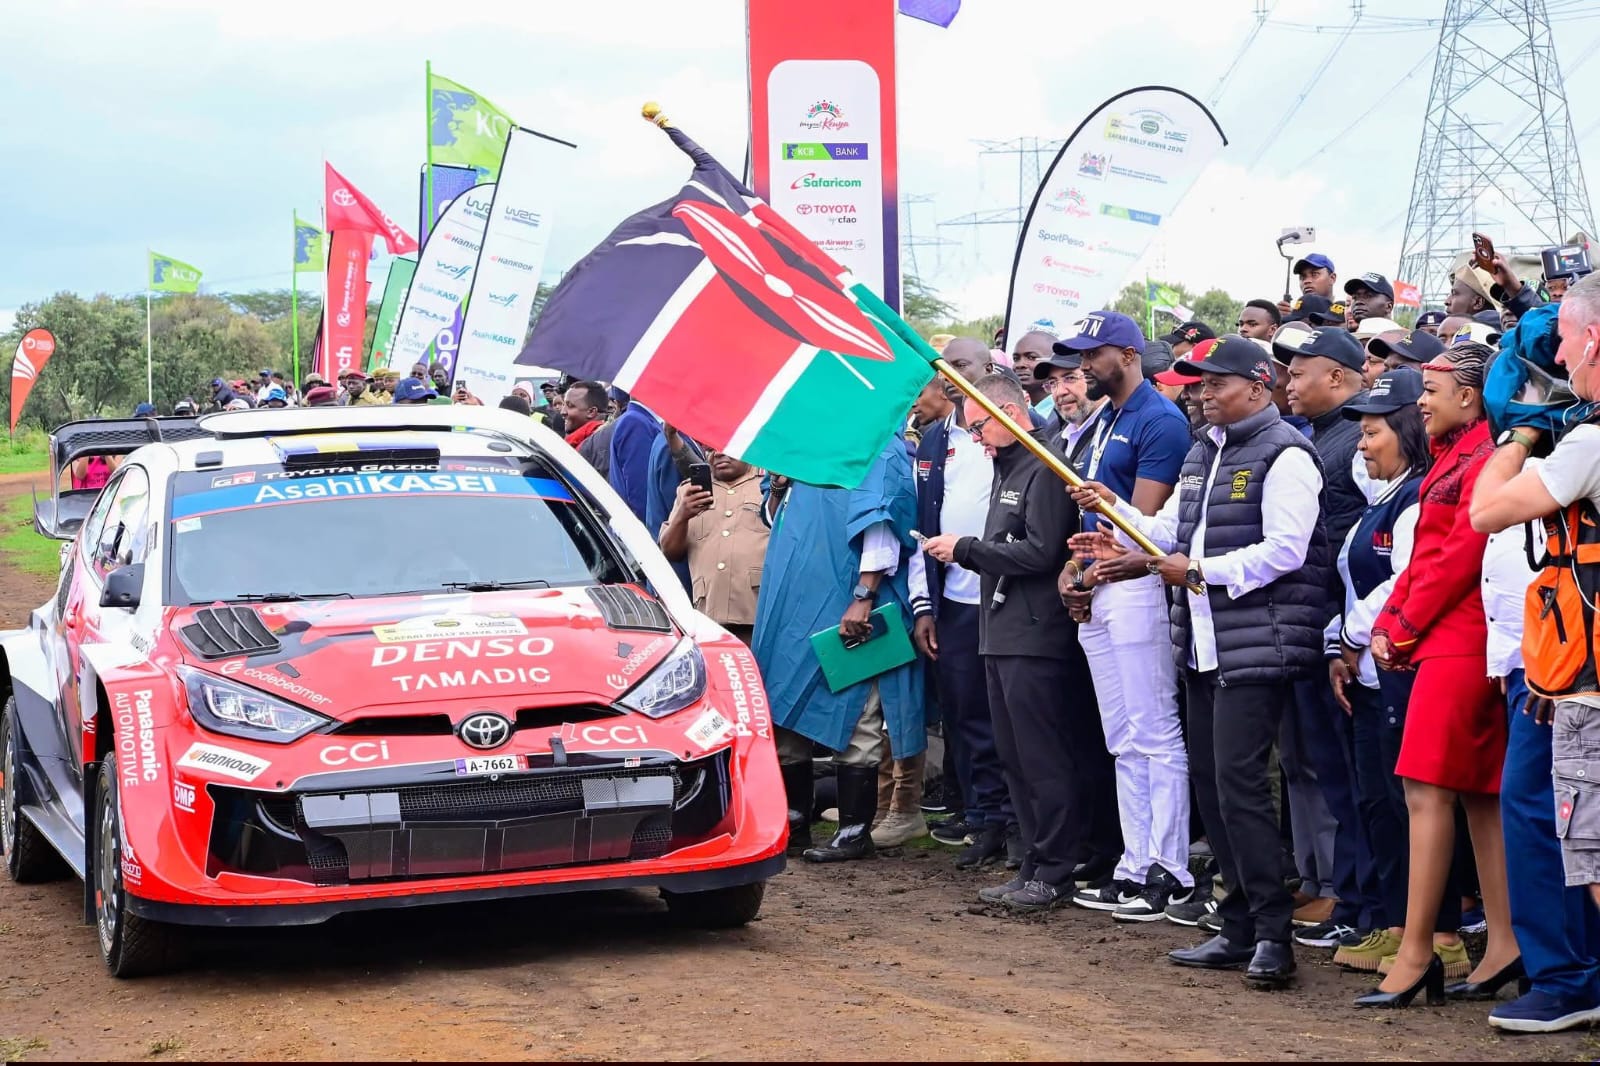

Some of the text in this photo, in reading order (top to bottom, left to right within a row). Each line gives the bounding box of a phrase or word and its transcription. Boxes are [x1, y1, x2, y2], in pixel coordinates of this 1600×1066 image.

[797, 147, 859, 156] KCB BANK
[803, 176, 861, 188] Safaricom
[813, 204, 856, 214] TOYOTA
[838, 216, 857, 224] cfao
[172, 269, 197, 281] KCB
[1046, 286, 1080, 300] TOYOTA
[262, 464, 521, 480] TOYOTA GAZOO Racing
[214, 475, 254, 488] GR
[371, 637, 555, 667] DENSO
[243, 667, 333, 706] codebeamer
[392, 667, 551, 692] TAMADIC
[719, 652, 752, 737] Panasonic
[736, 650, 770, 739] AUTOMOTIVE
[114, 692, 139, 787] AUTOMOTIVE
[133, 689, 158, 782] Panasonic
[470, 758, 513, 772] A-7662
[174, 786, 195, 807] OMP
